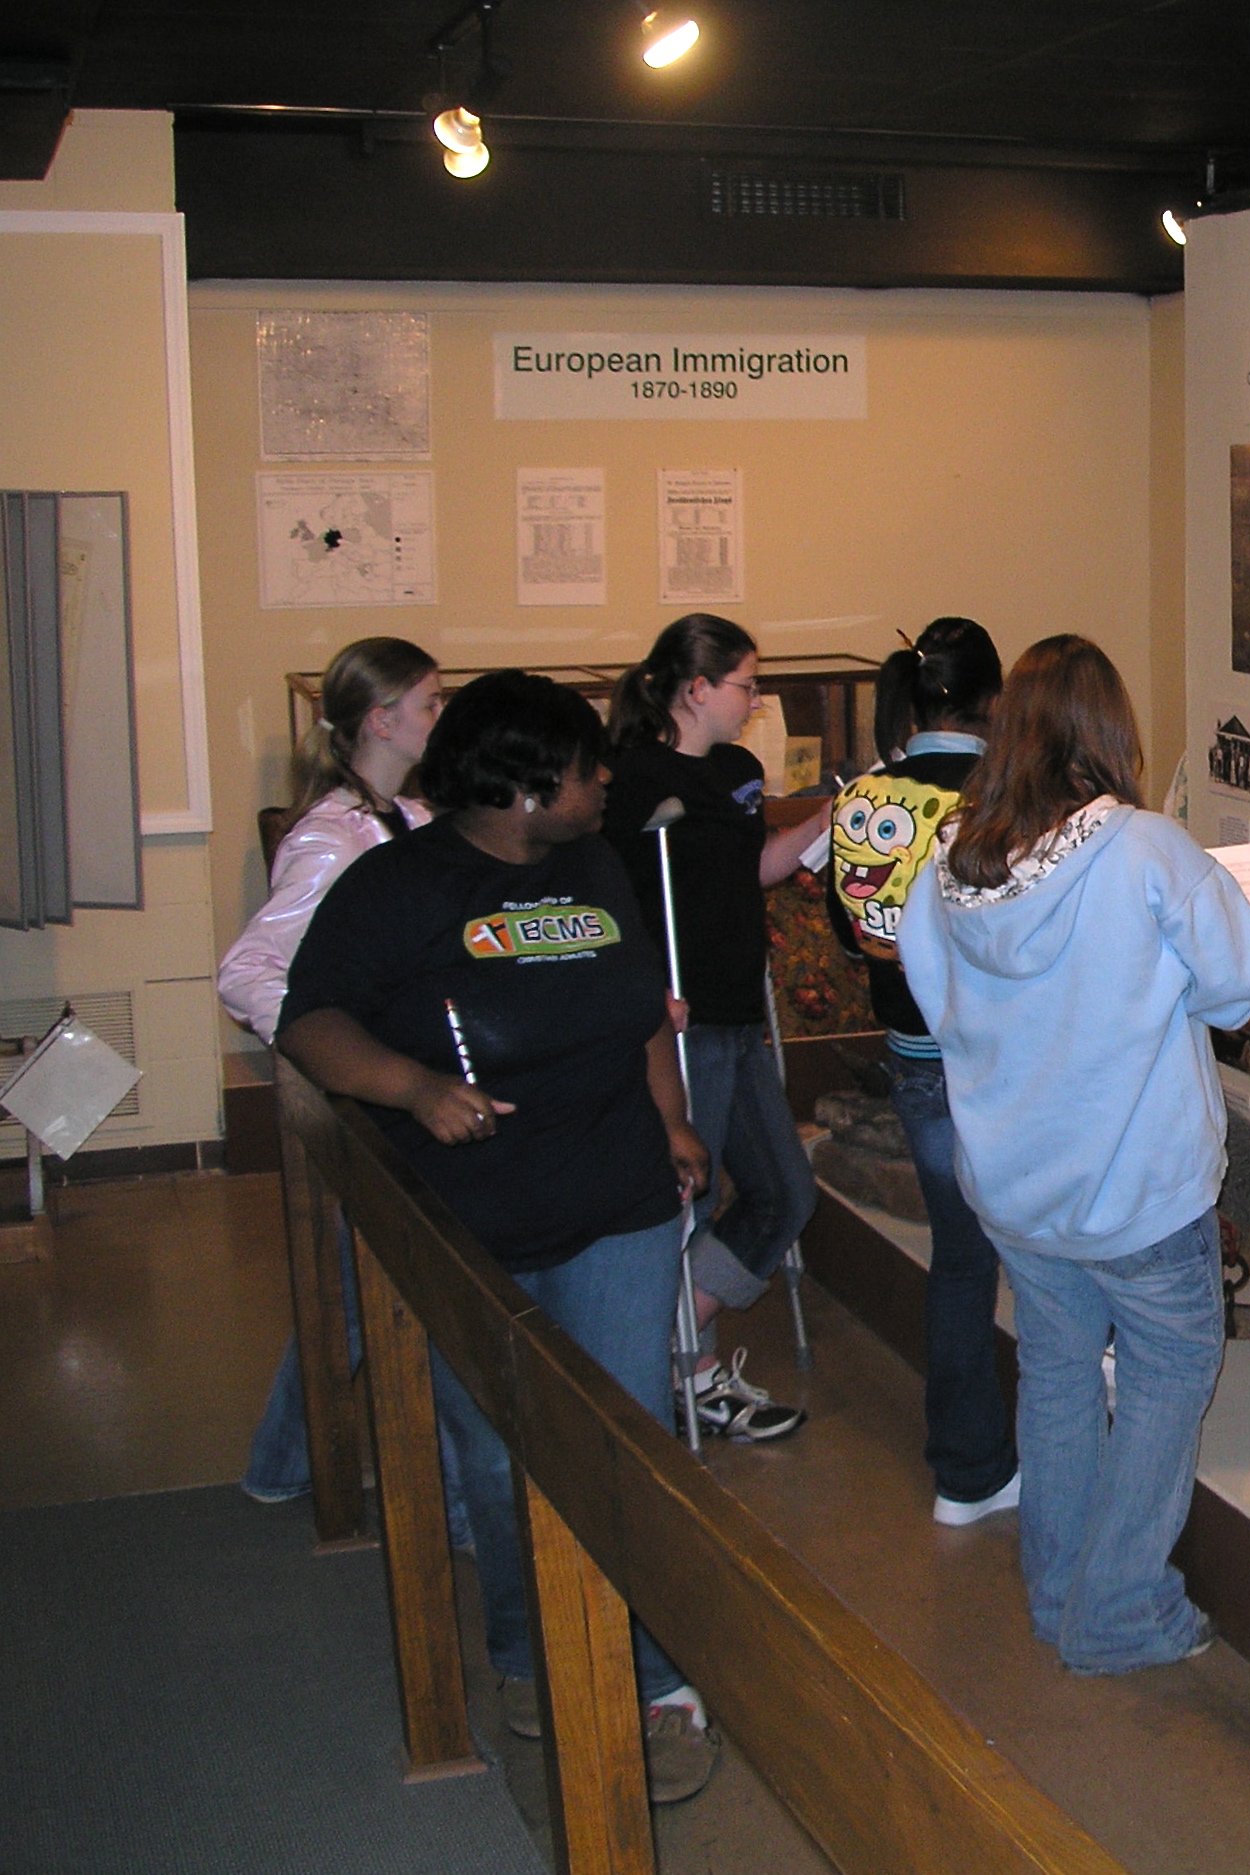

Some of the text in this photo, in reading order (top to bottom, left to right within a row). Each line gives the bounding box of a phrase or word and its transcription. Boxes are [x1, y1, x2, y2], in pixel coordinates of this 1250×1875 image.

[513, 346, 849, 379] European Immigration
[631, 381, 738, 399] 1870-1890
[516, 913, 605, 944] BCMS
